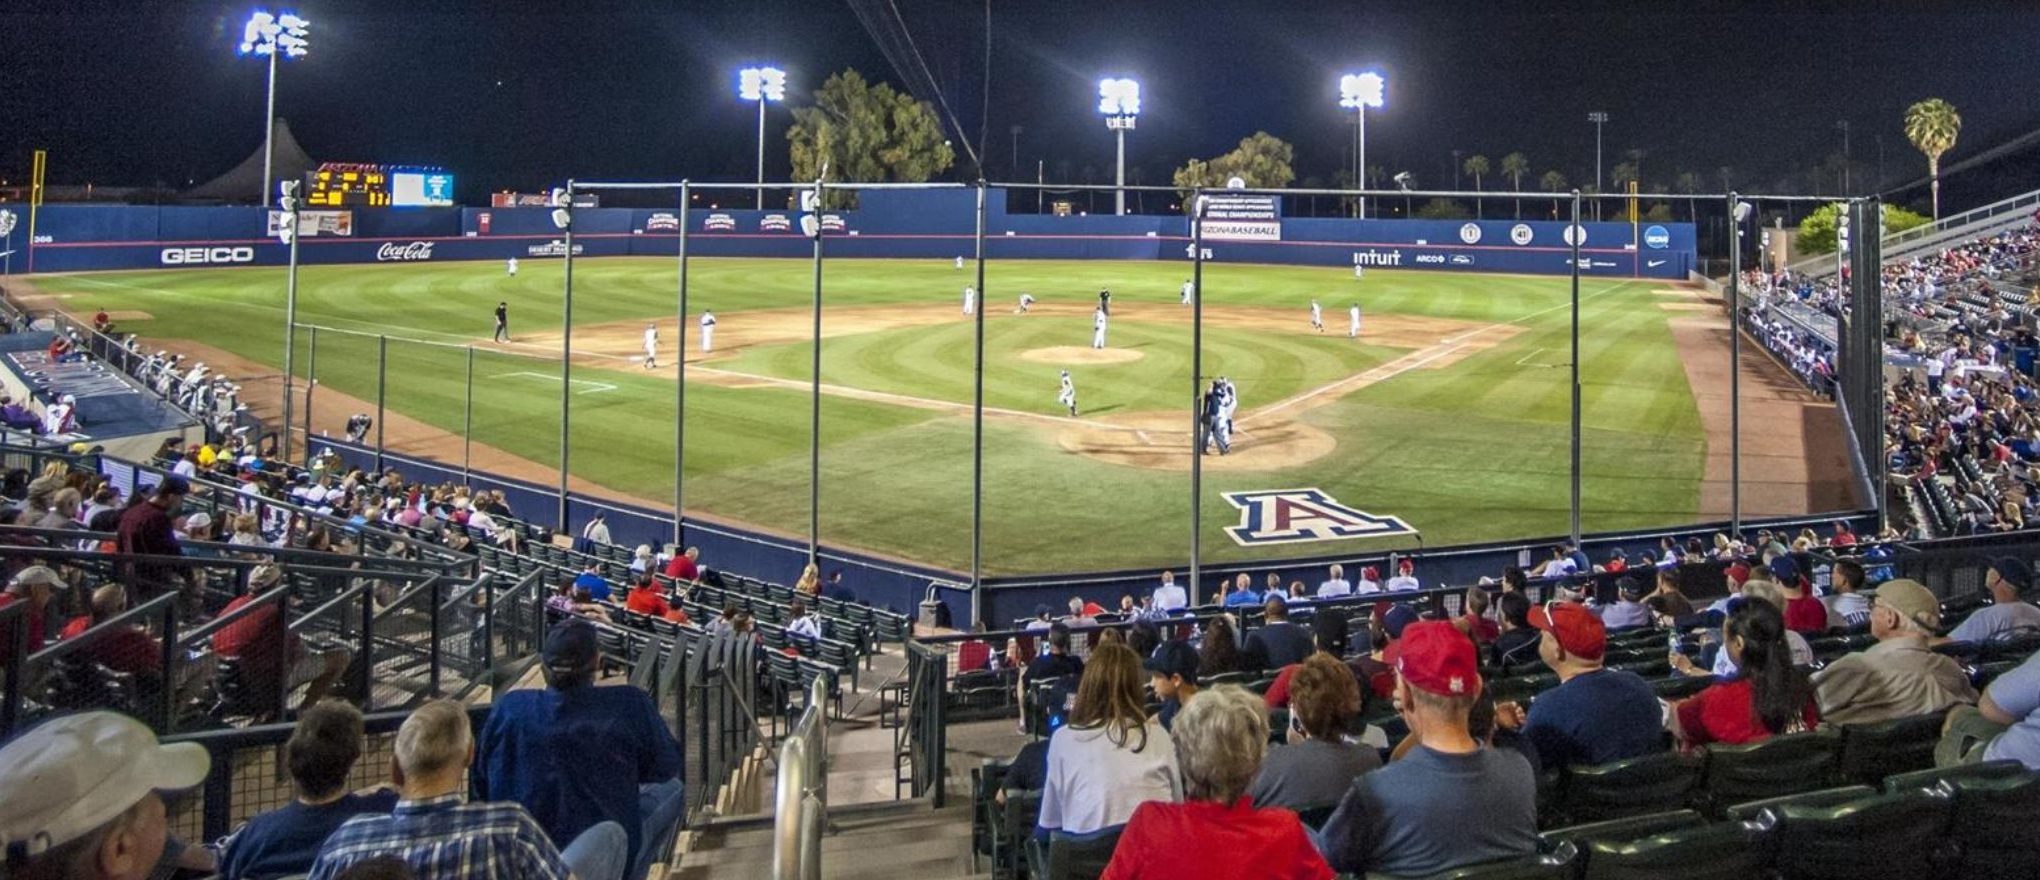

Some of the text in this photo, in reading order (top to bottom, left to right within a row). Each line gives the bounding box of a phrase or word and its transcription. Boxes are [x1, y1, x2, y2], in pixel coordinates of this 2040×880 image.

[161, 247, 254, 264] GEICO
[1416, 255, 1438, 263] ARCO
[1220, 487, 1419, 547] A
